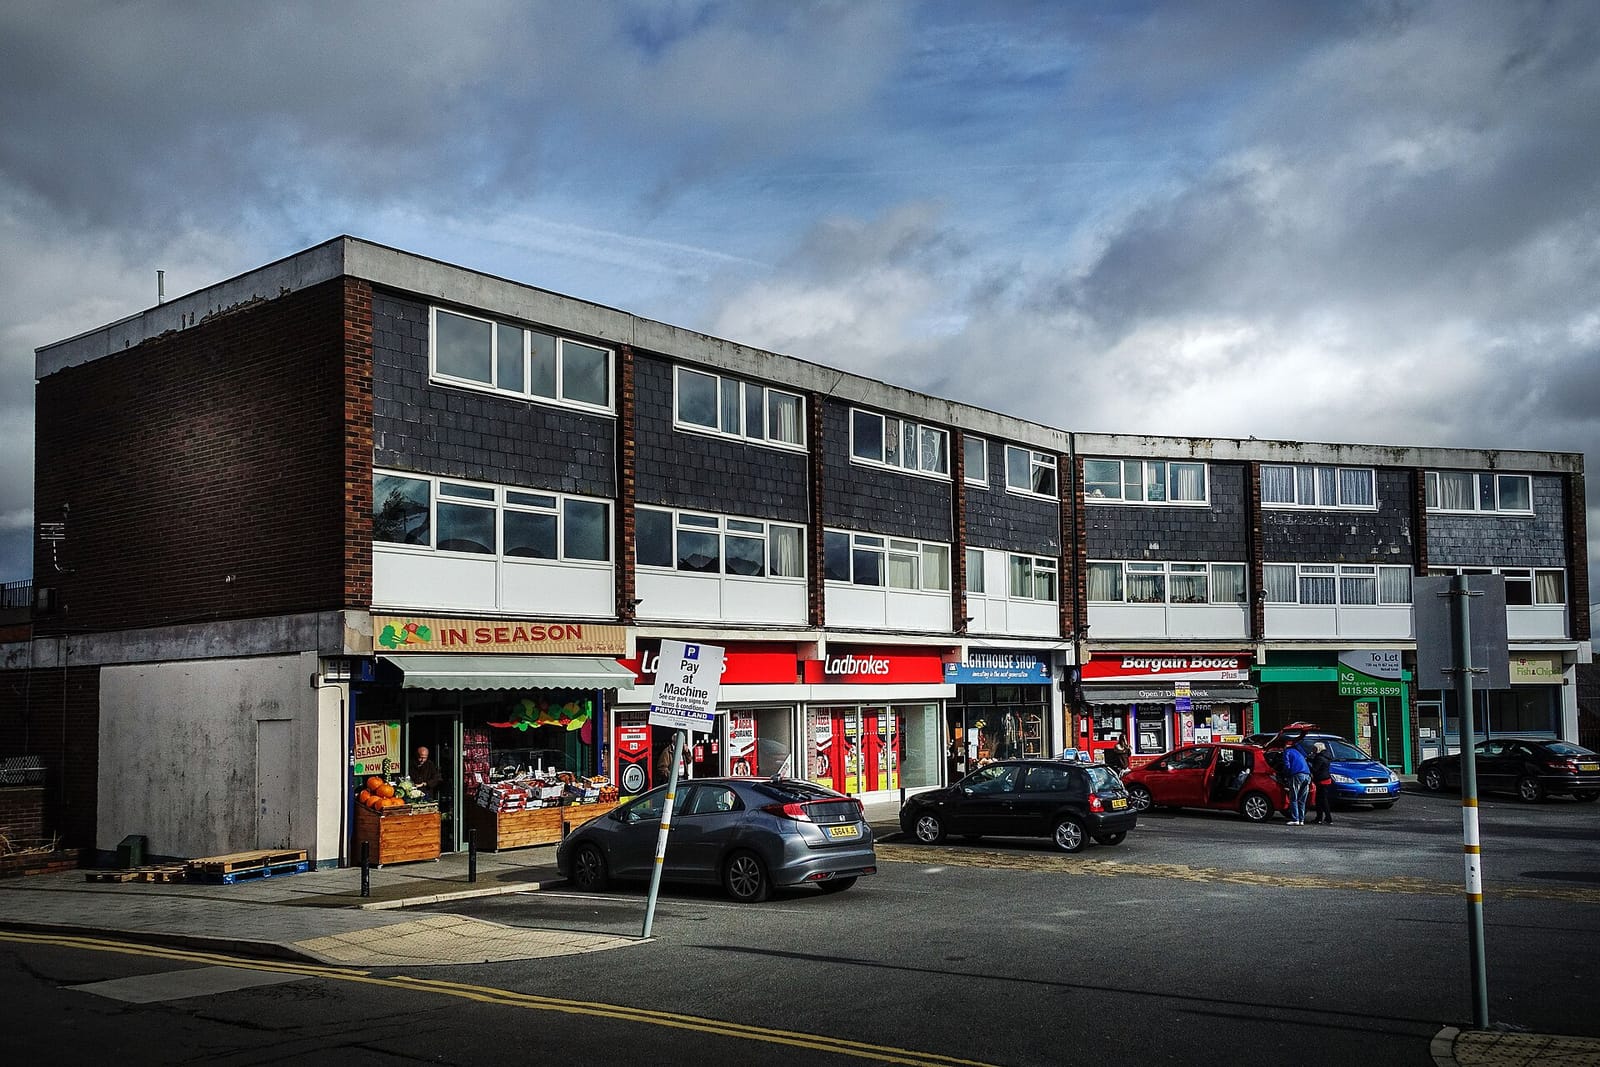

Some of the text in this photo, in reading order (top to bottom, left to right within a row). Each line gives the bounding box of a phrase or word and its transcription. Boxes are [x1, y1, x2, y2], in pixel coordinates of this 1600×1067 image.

[440, 624, 583, 646] IN SEASON
[687, 647, 696, 657] P
[1370, 652, 1399, 662] To Let
[680, 660, 700, 674] Pay
[824, 653, 890, 675] Ladbrokes
[1015, 654, 1037, 669] SHOP
[1121, 656, 1239, 672] Bargain Booze
[682, 674, 694, 684] at
[1221, 671, 1238, 680] Plus
[664, 682, 708, 699] Machine
[1139, 690, 1159, 699] Open
[1190, 690, 1209, 698] Week
[1341, 686, 1400, 695] 0115 958 8599
[677, 695, 688, 703] park
[661, 700, 675, 708] terms
[680, 703, 705, 712] conditions
[654, 706, 686, 716] PRIVATE
[687, 711, 708, 720] LAND
[356, 725, 371, 745] IN
[356, 745, 386, 757] SEASON
[365, 764, 381, 772] NOW
